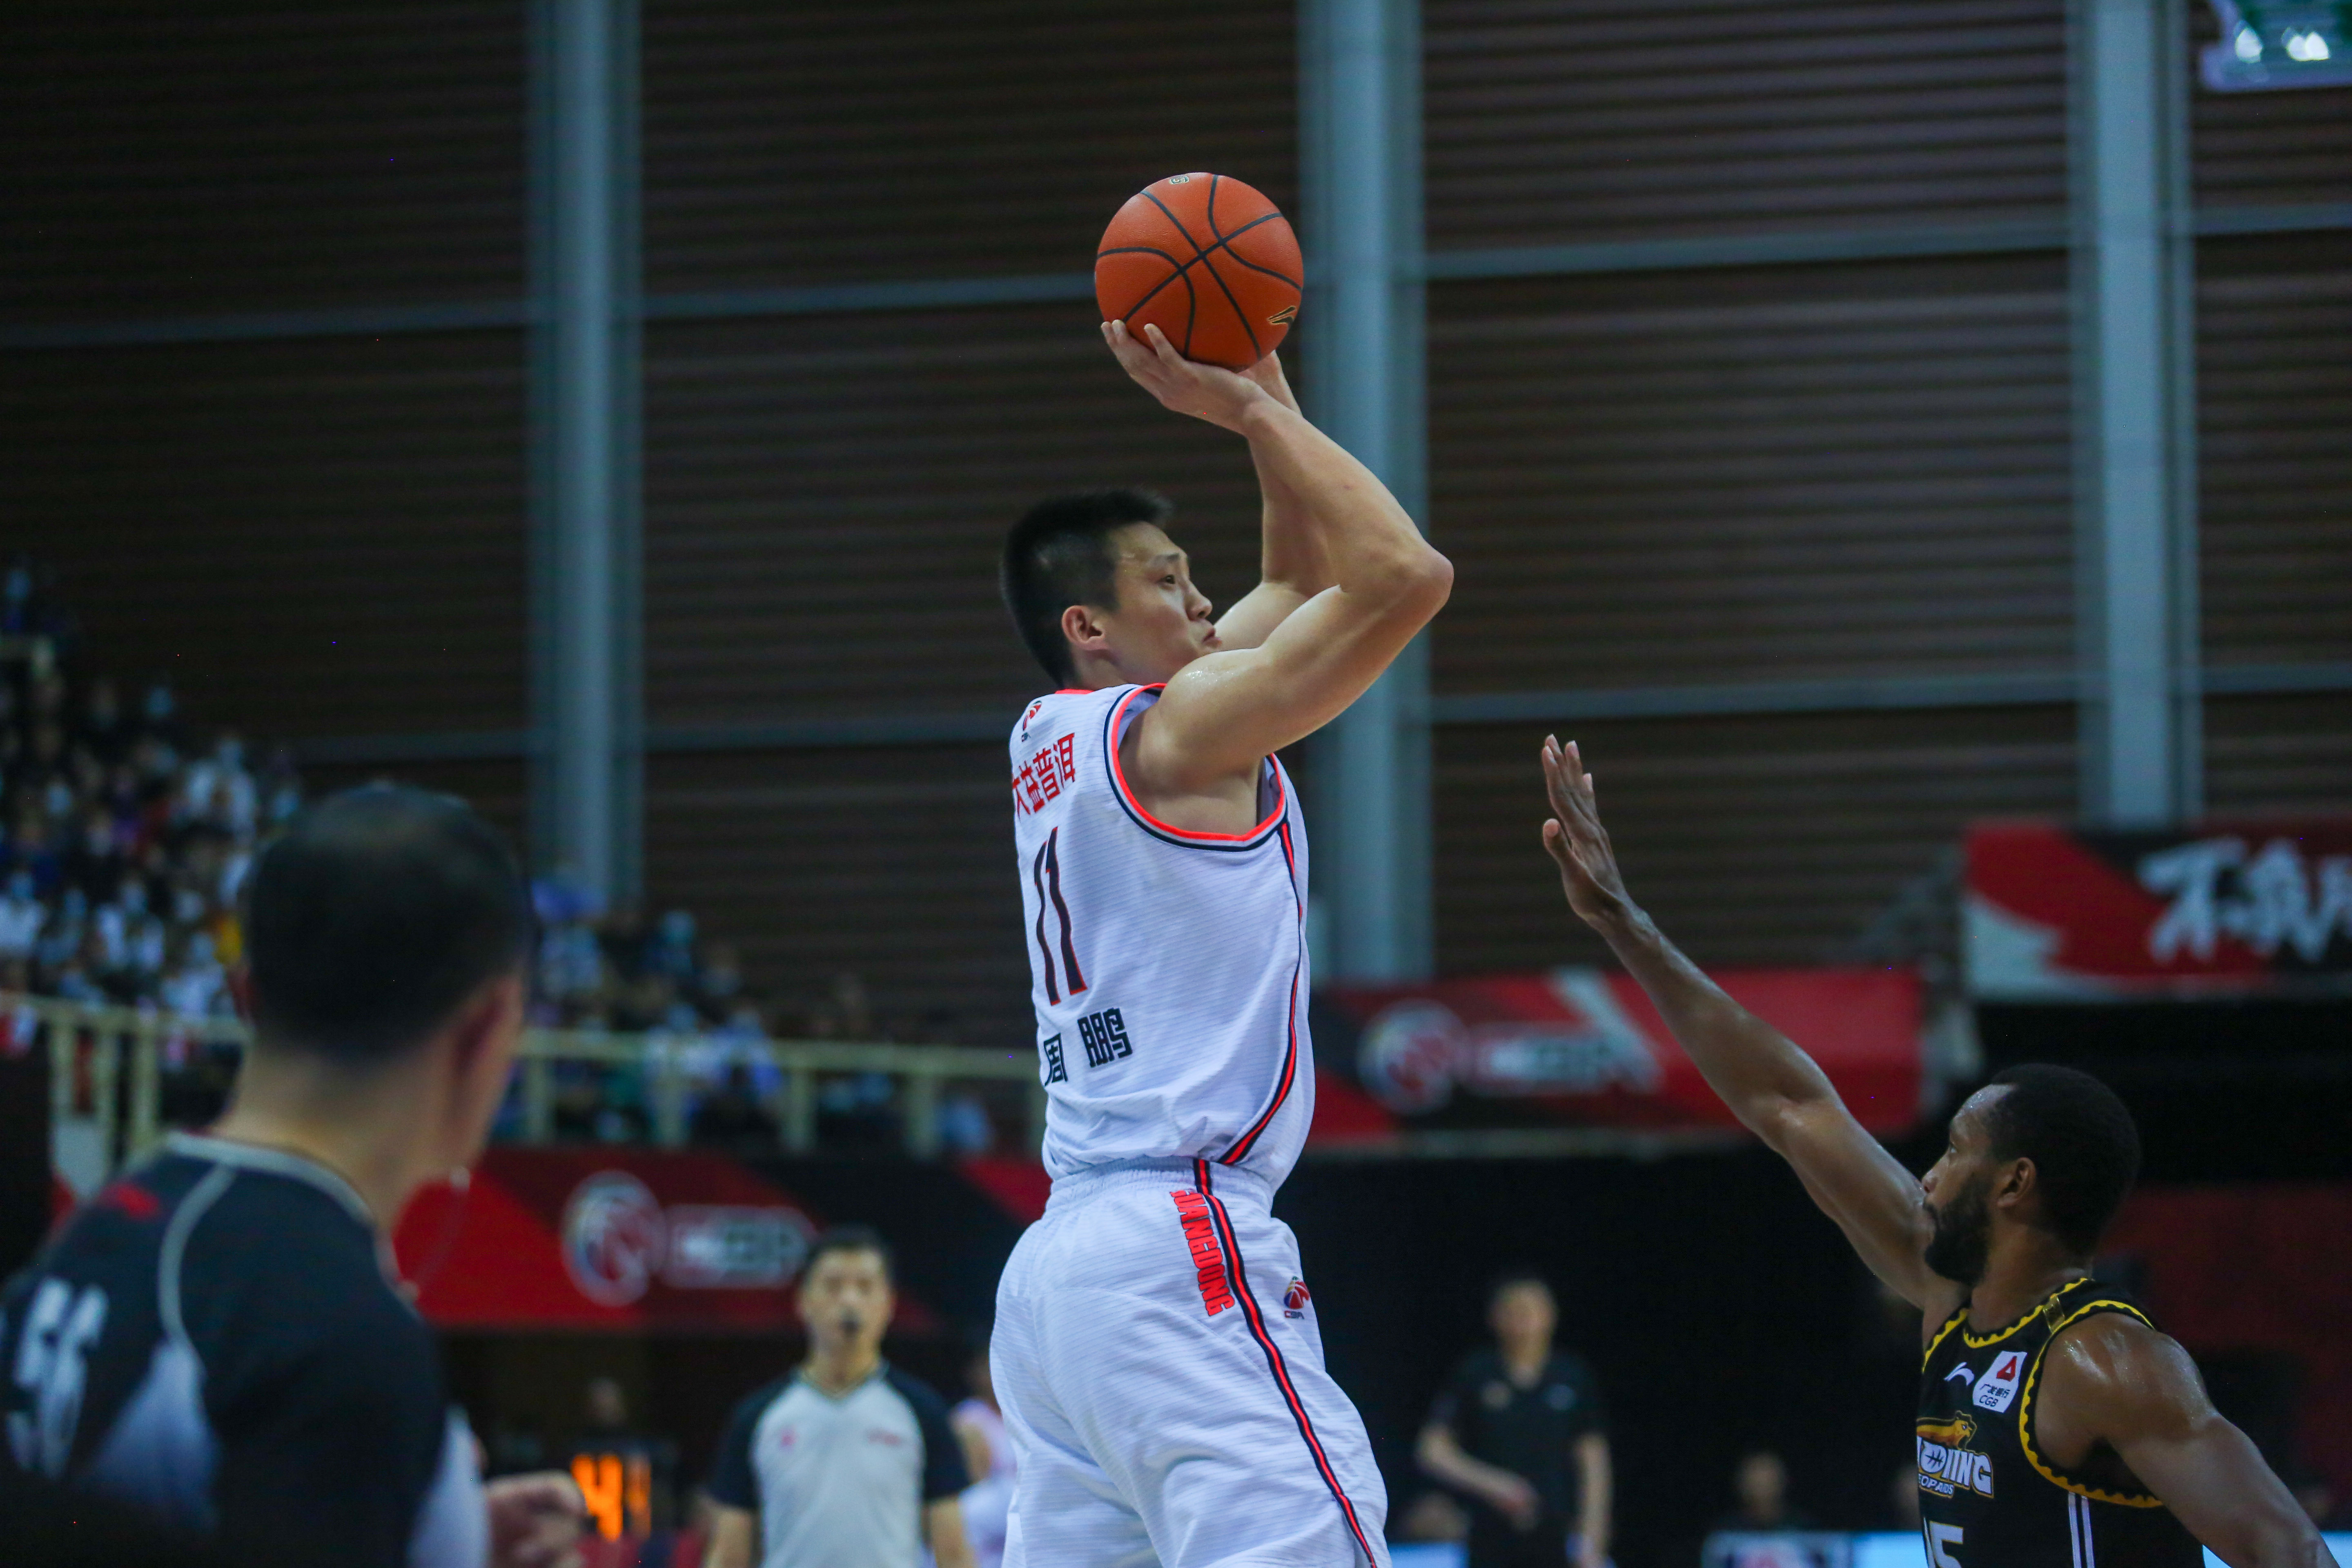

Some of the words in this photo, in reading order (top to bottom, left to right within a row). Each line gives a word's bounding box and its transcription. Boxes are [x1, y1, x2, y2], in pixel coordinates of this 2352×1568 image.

[1034, 826, 1088, 1006] 11
[1044, 1007, 1133, 1086] 周鹏
[1979, 1395, 1999, 1407] CGB
